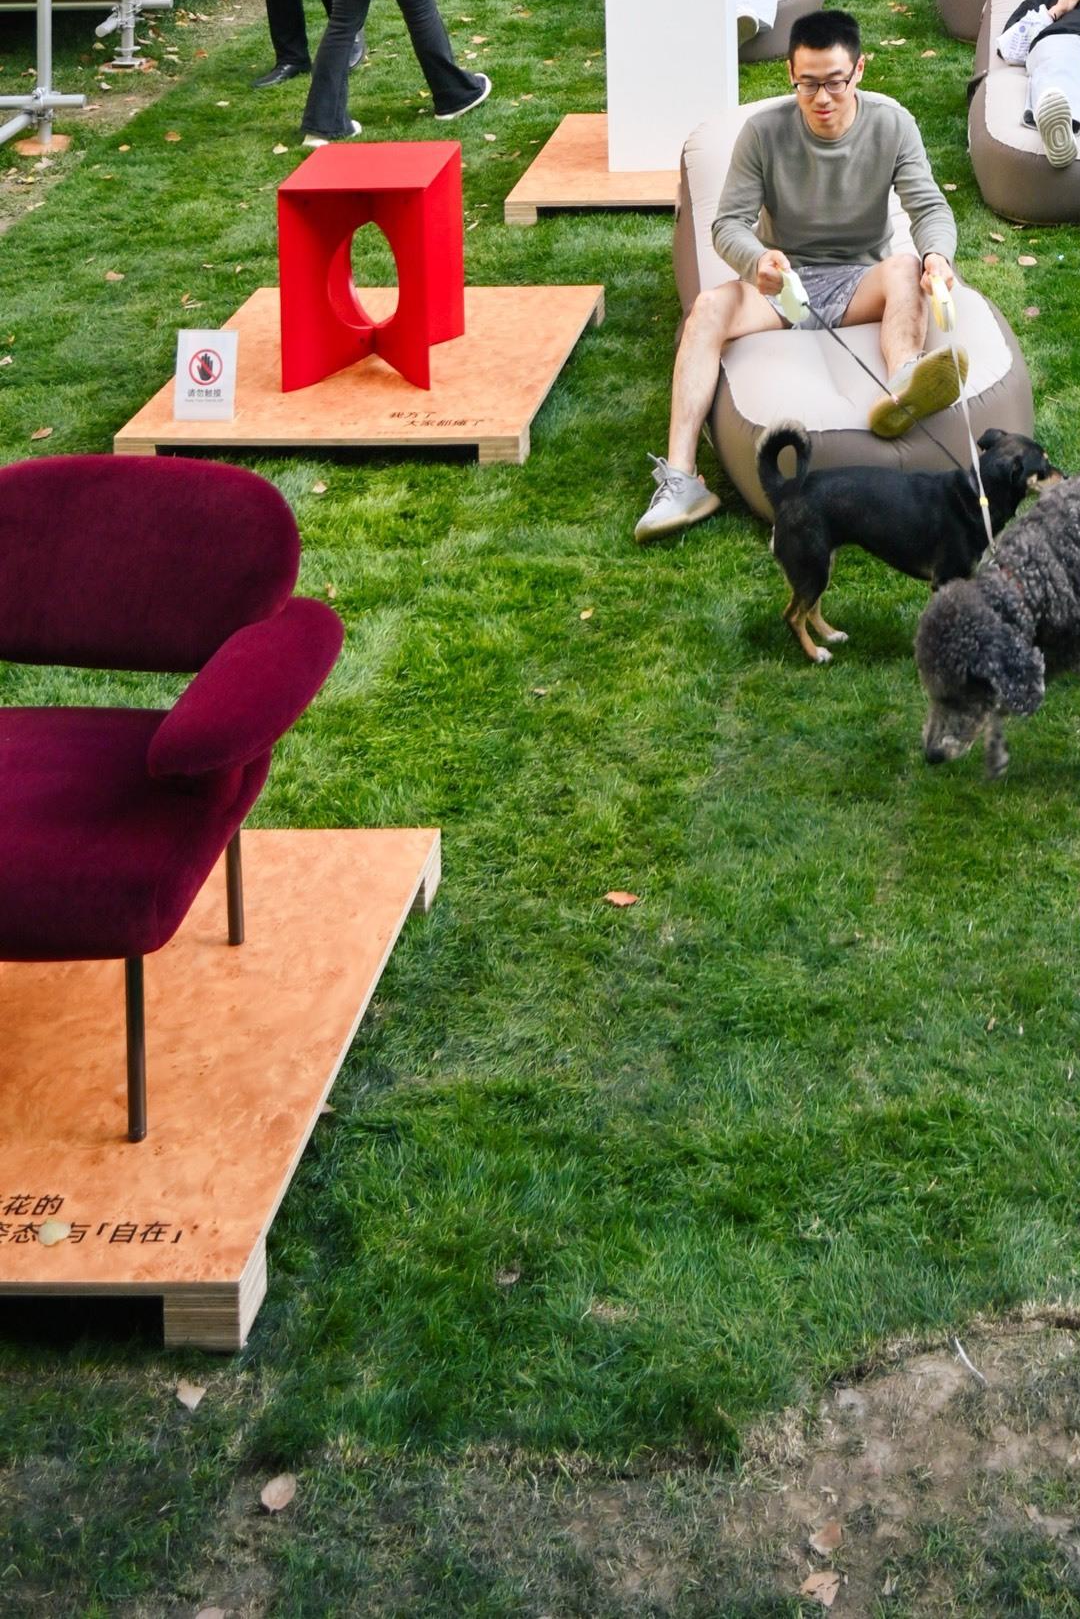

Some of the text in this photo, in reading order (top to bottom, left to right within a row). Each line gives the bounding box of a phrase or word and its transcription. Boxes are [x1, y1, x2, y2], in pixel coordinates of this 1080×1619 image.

[187, 388, 221, 398] 请勿触摸
[0, 1193, 65, 1216] 花的
